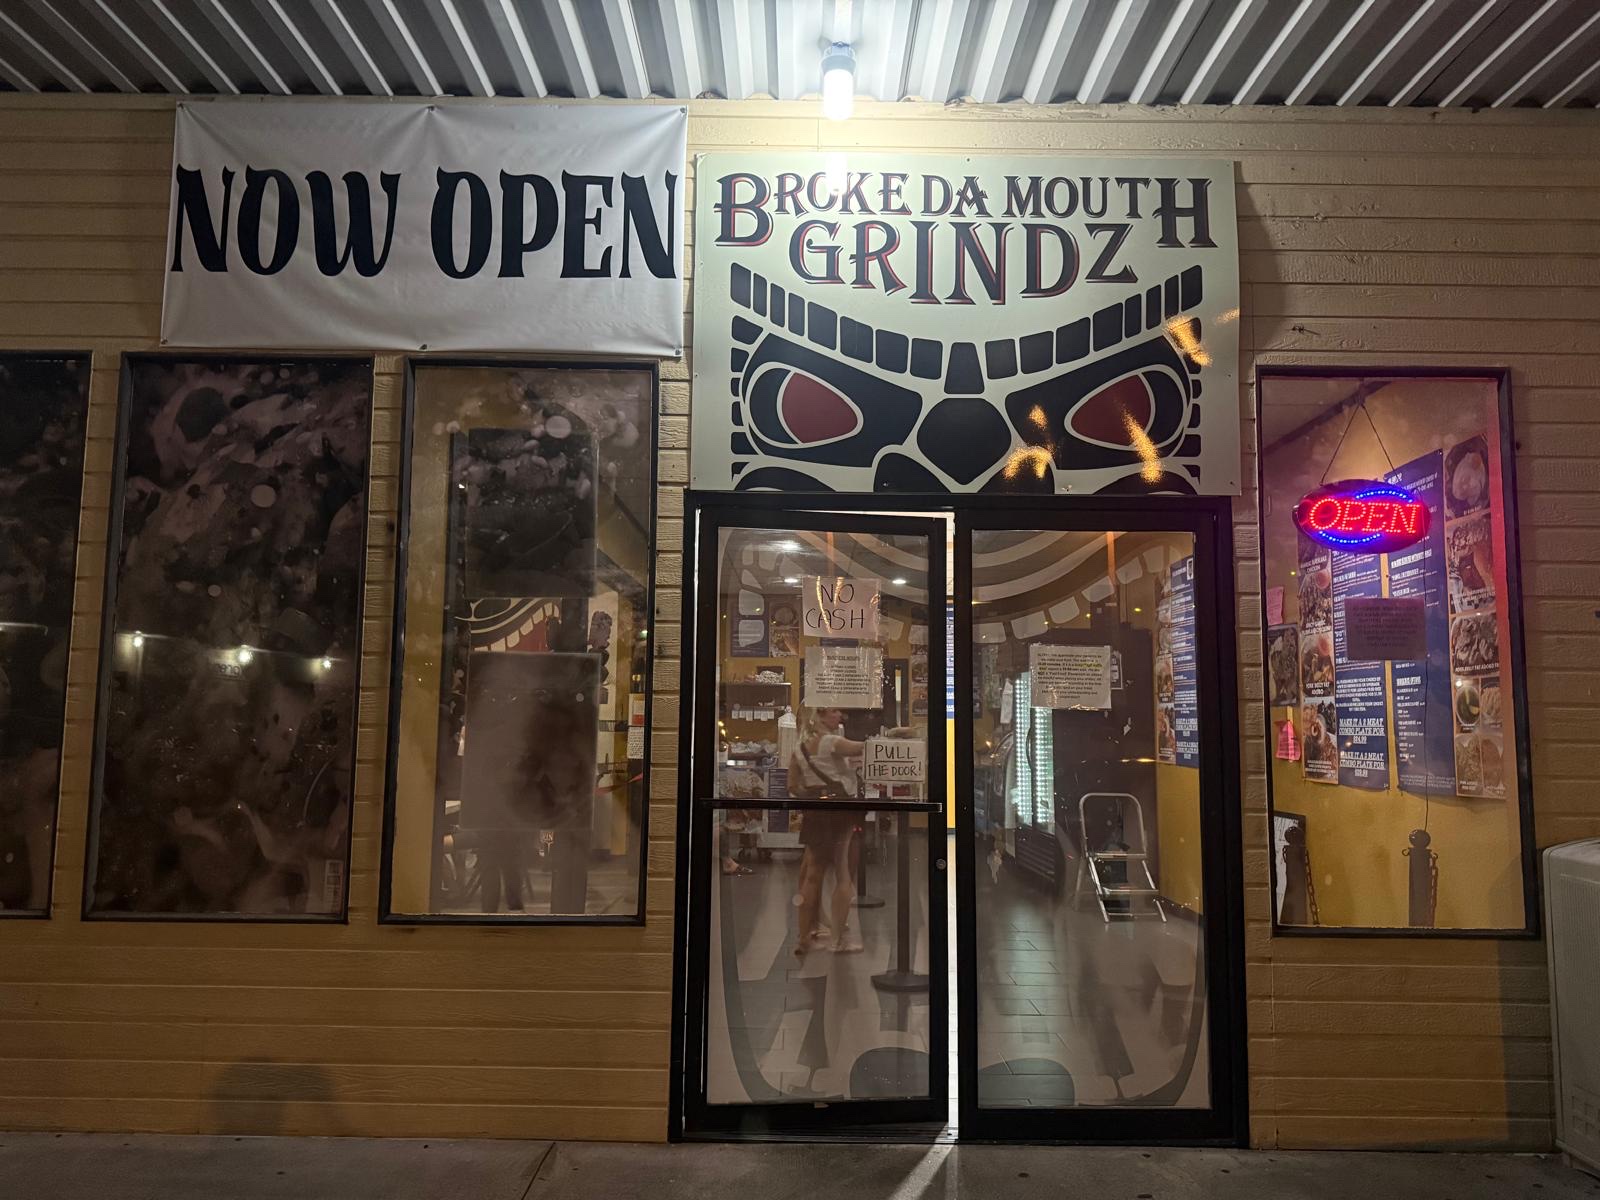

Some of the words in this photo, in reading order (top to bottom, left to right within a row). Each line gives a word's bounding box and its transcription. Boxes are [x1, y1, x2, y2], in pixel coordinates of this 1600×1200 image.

[170, 163, 401, 277] NOW
[430, 165, 678, 279] OPEN
[920, 175, 991, 218] DA
[1003, 175, 1218, 248] MOUTH
[788, 219, 1138, 305] GRINDZ
[1309, 498, 1421, 534] OPEN
[821, 584, 854, 603] NO
[806, 608, 864, 630] CASH
[875, 744, 917, 759] PULL
[868, 763, 888, 776] THE
[891, 761, 921, 776] DOOR!
